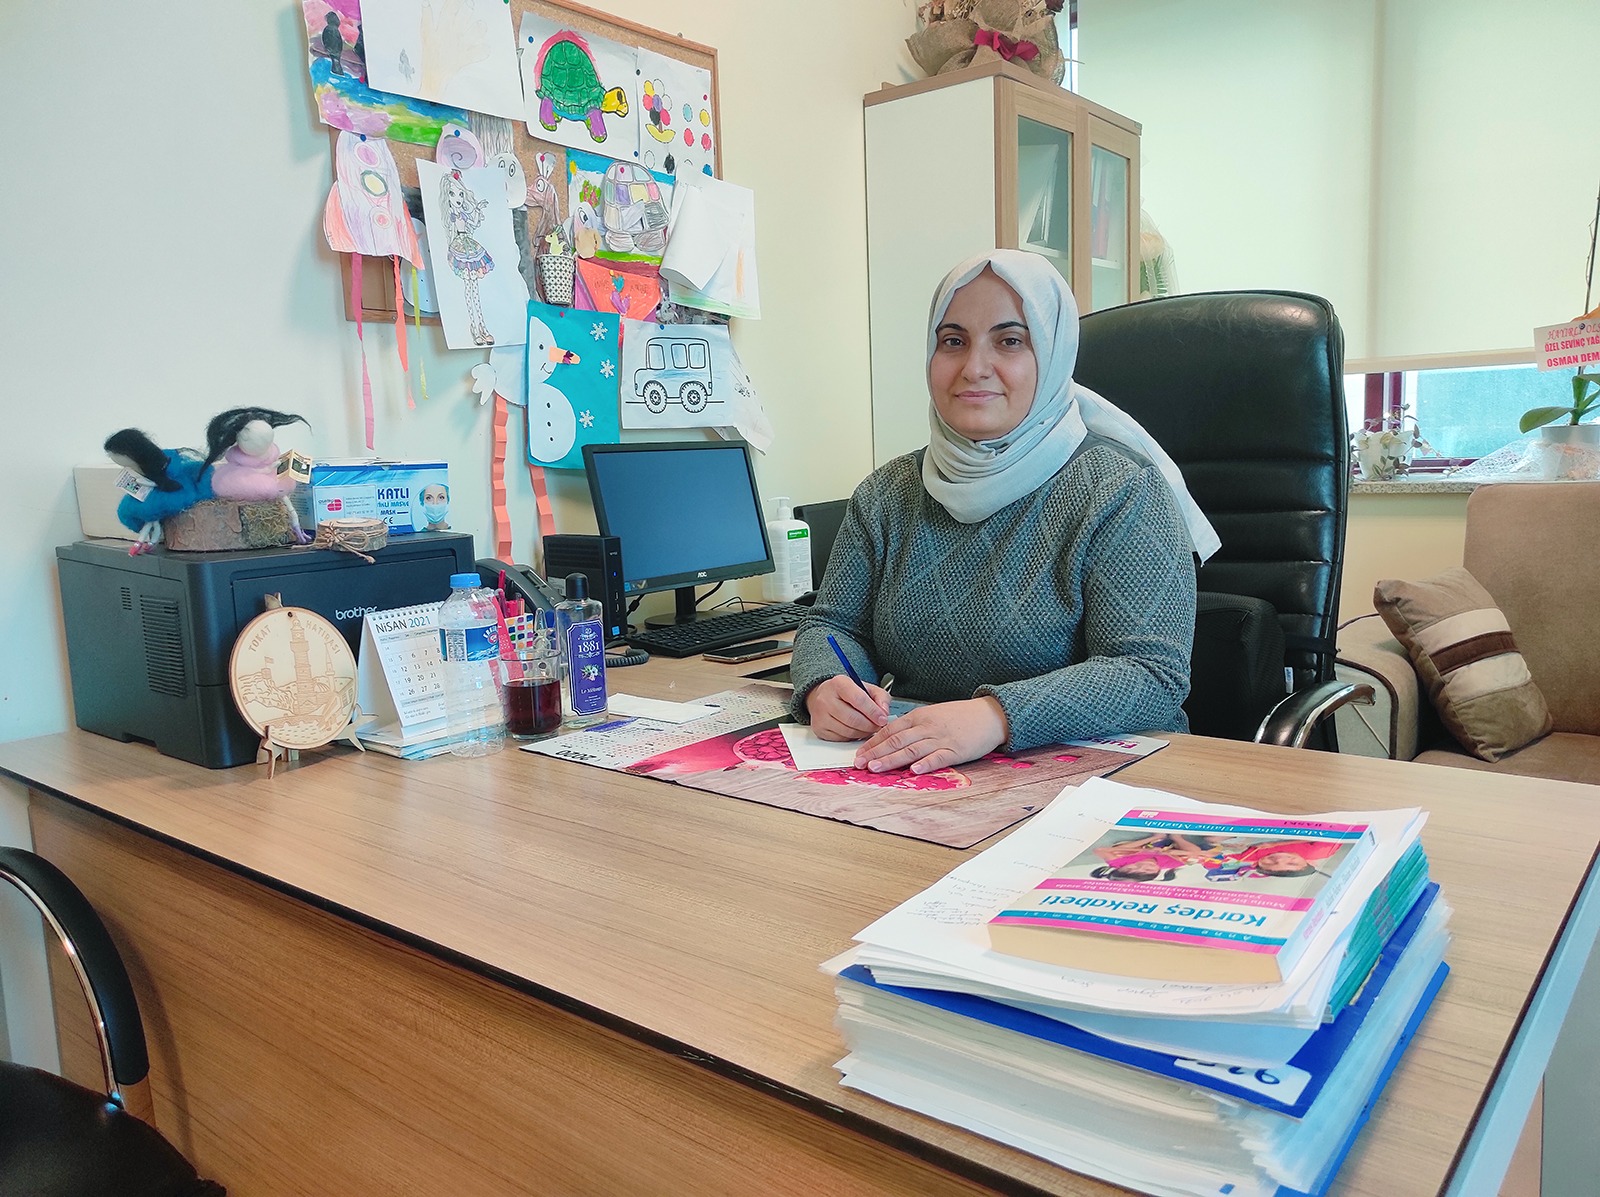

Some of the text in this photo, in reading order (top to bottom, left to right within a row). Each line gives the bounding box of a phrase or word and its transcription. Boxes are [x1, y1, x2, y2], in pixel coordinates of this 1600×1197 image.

[1547, 352, 1600, 367] OSMAN DEM
[378, 488, 409, 499] KATLI
[335, 606, 378, 620] brother
[409, 616, 431, 628] 2021
[248, 625, 272, 652] TOKAT
[306, 620, 340, 654] HATIRASI
[578, 640, 600, 653] 1881
[1040, 896, 1268, 926] Kardeş Rekabeti
